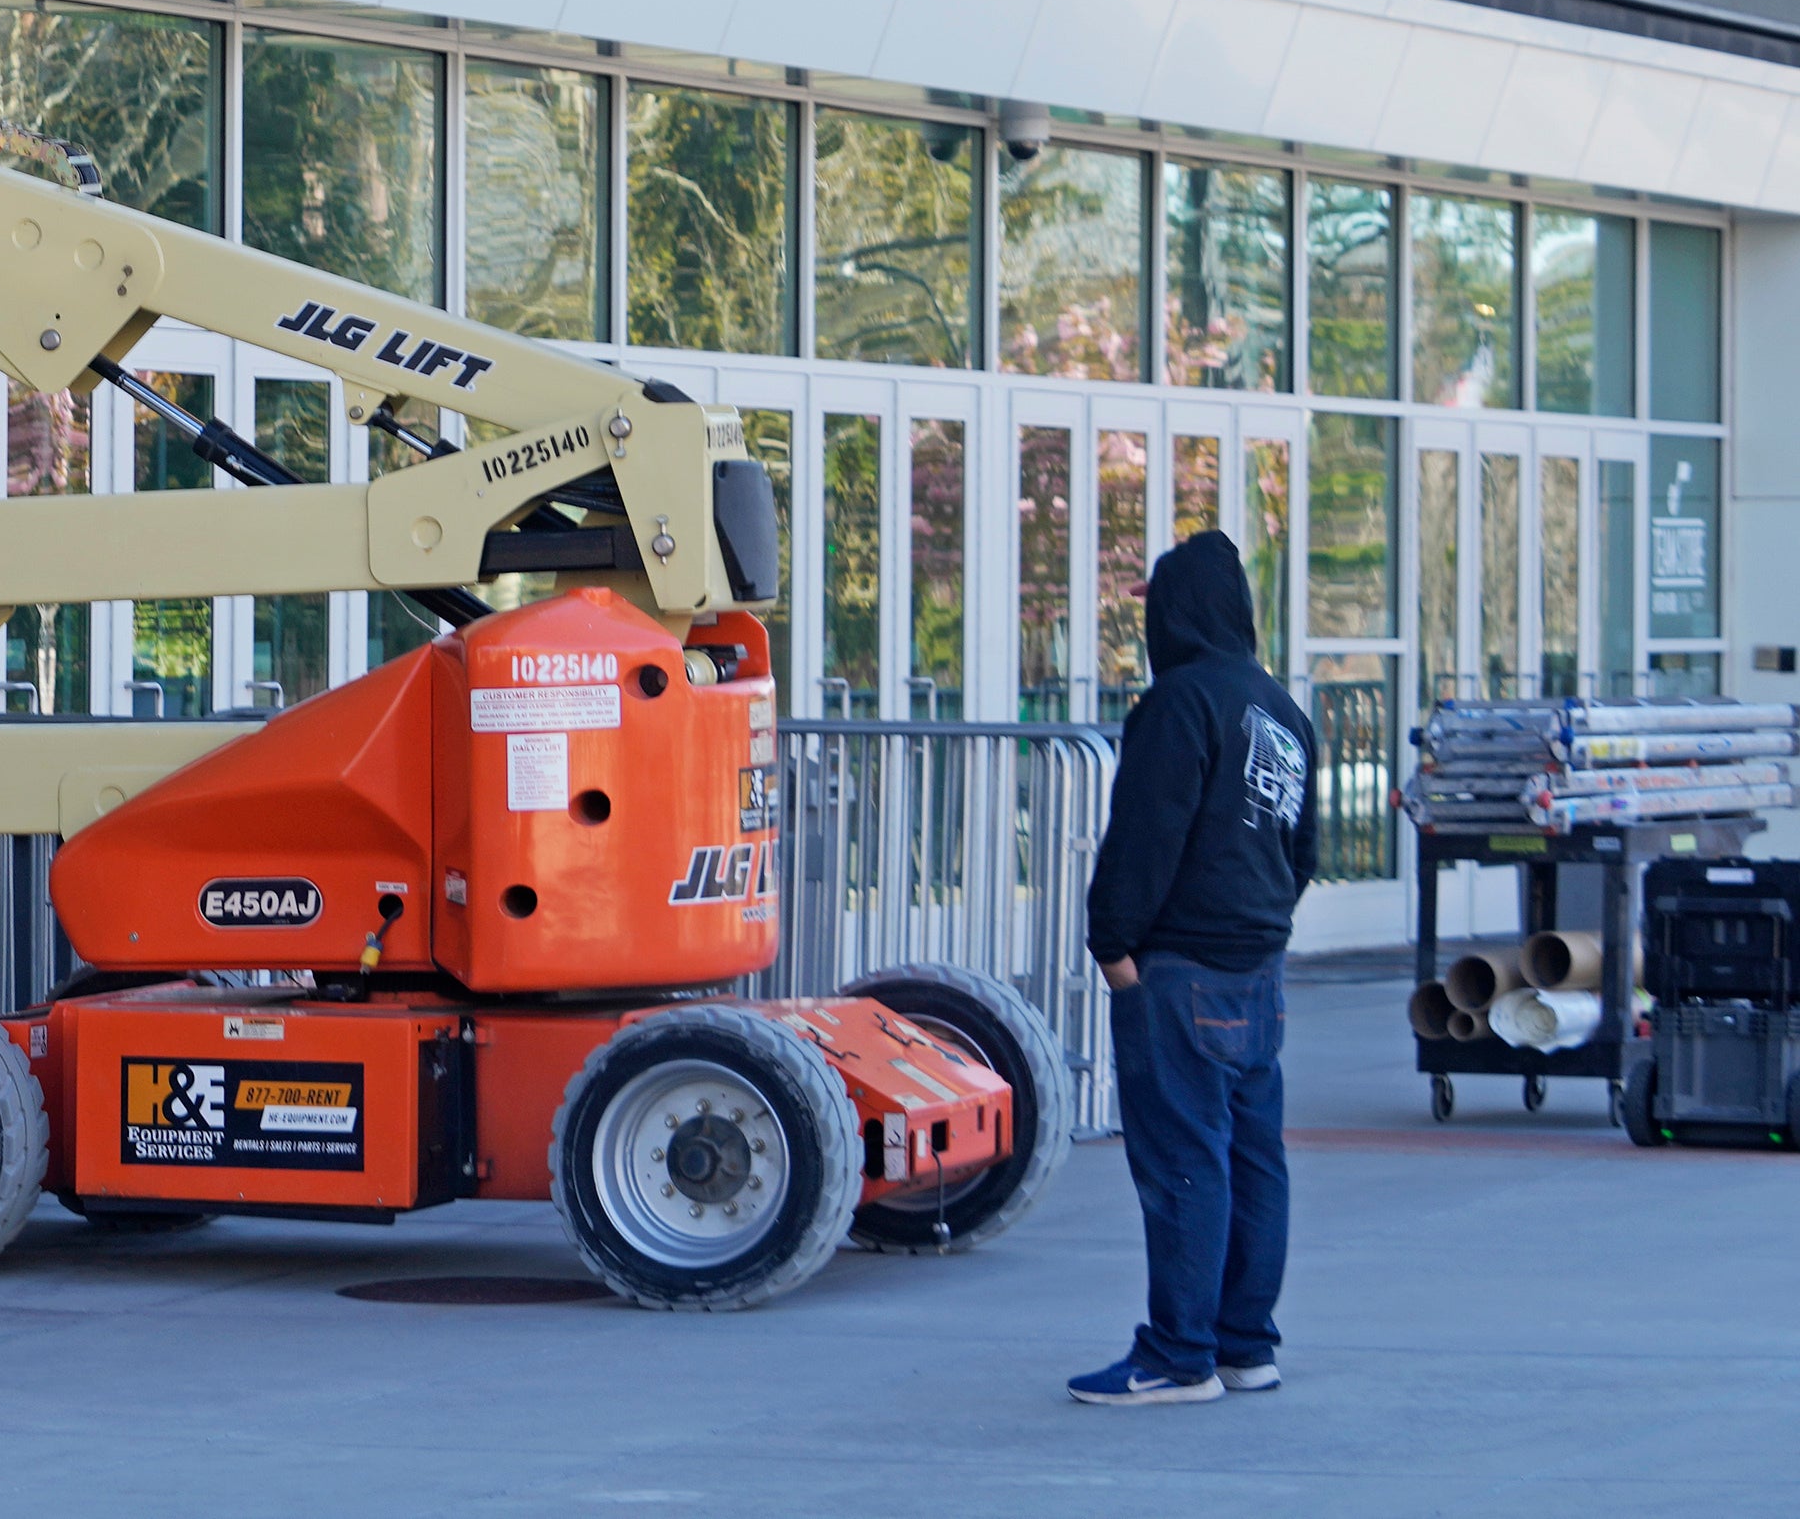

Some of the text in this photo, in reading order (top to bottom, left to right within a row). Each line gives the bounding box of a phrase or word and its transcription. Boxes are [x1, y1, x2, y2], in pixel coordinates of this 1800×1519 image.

[273, 298, 496, 390] JLG LIFT
[480, 424, 591, 484] 10225140
[511, 653, 618, 683] 10225140
[482, 688, 609, 701] CUSTOMER RESPONSIBILITY
[668, 842, 755, 906] JLG
[204, 889, 317, 918] E450AJ
[127, 1063, 225, 1129] H&E
[246, 1087, 342, 1106] 877-700-RENT
[268, 1112, 349, 1125] HE-EQUIPMENT.COM
[126, 1125, 225, 1145] EQUIPMENT
[233, 1138, 358, 1155] RENTALS SALES PARTS SERVICE
[135, 1141, 214, 1161] SERVICES
